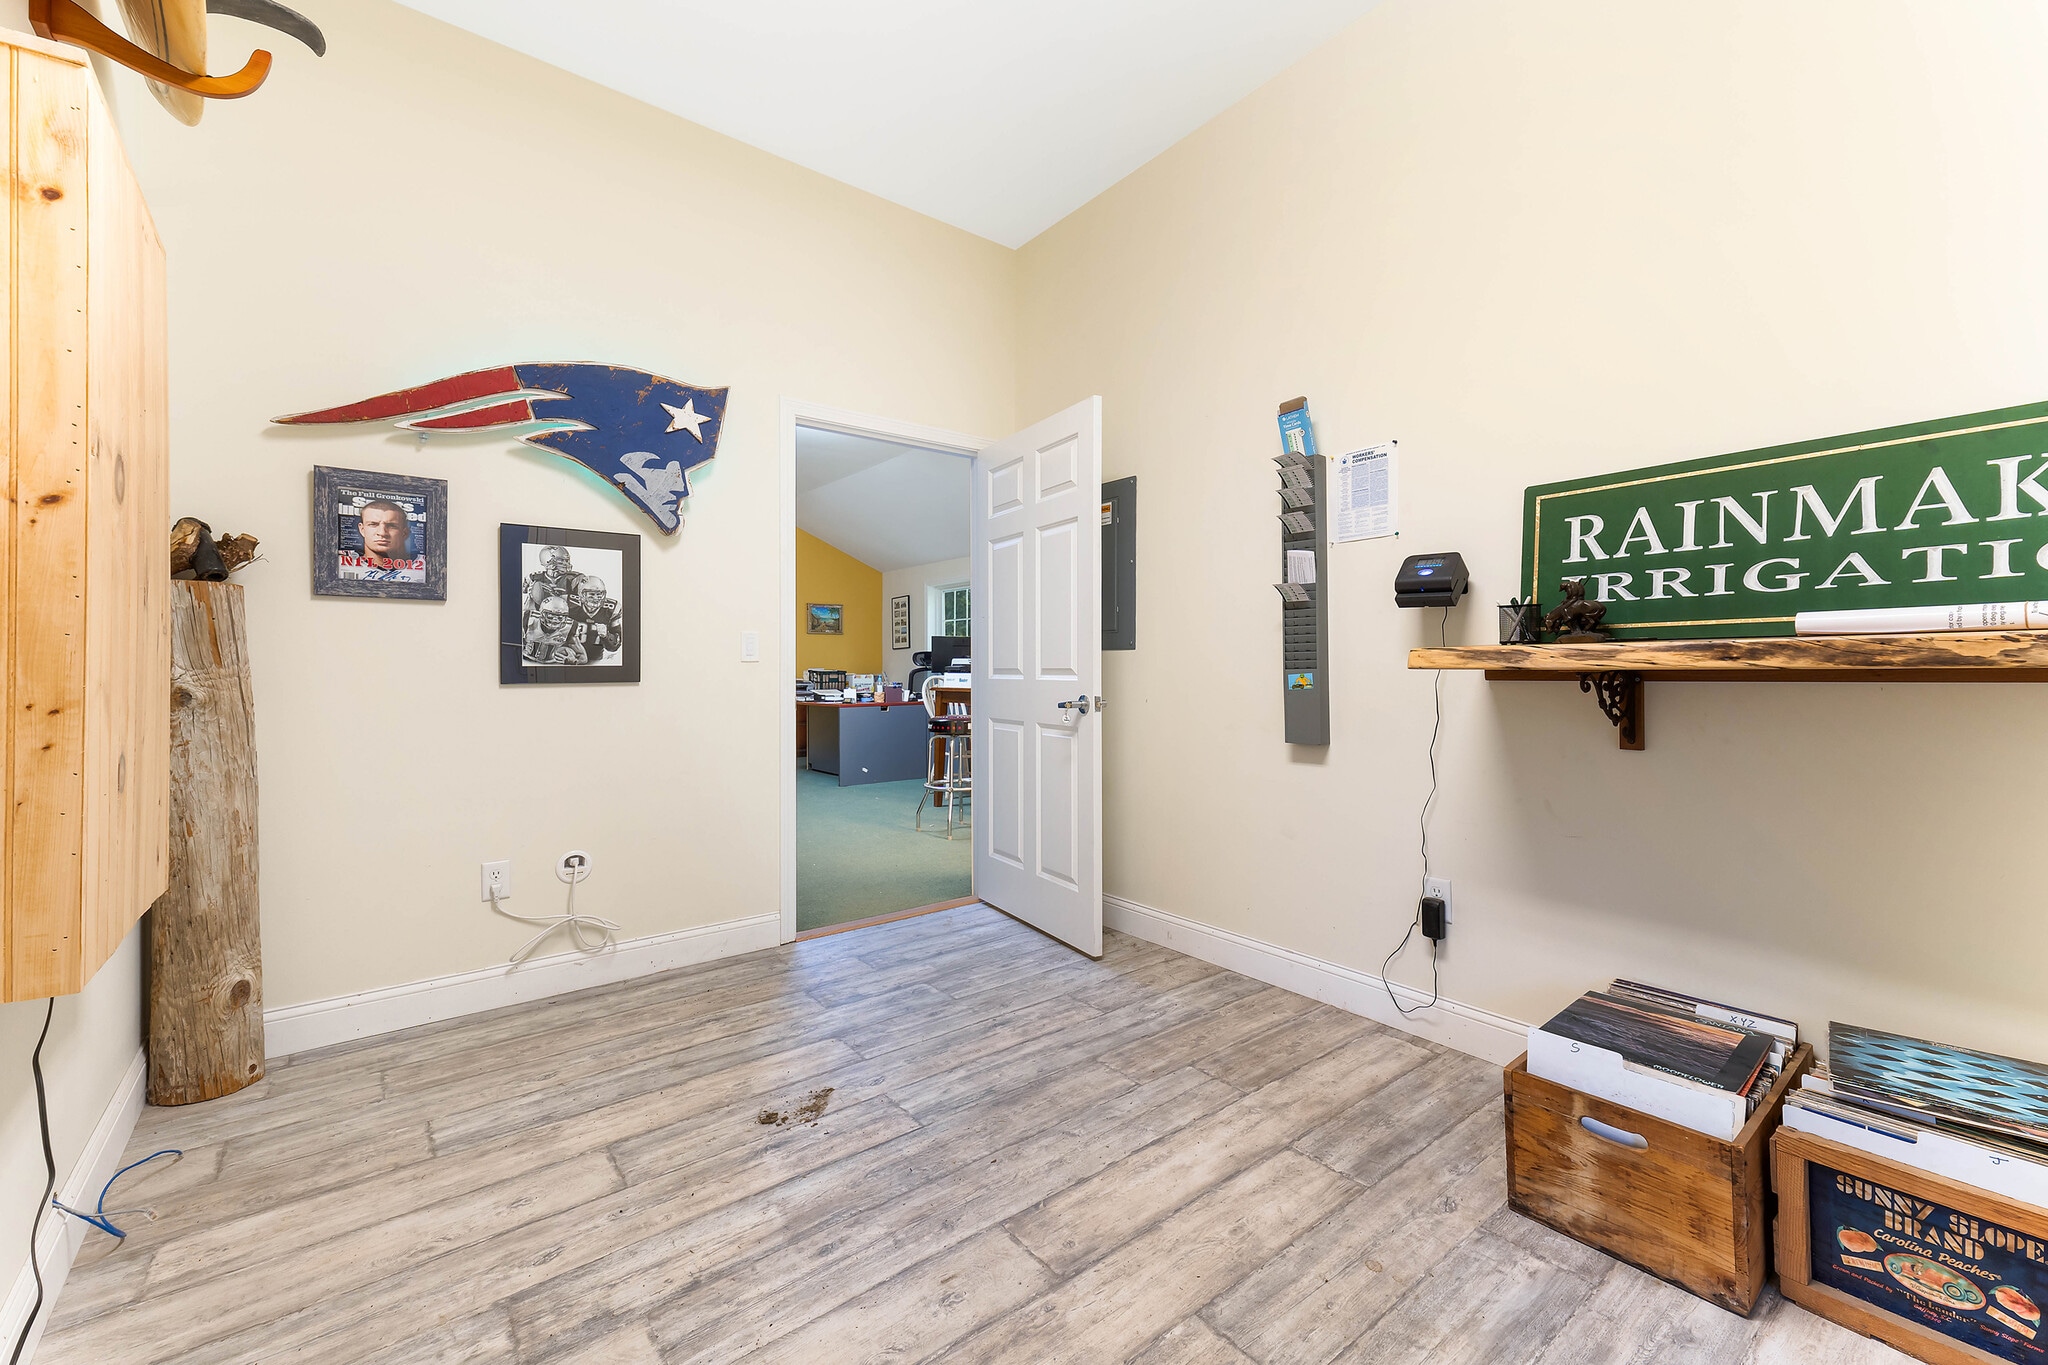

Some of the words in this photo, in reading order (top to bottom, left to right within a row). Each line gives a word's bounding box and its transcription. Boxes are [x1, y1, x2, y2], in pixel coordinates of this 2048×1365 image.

[1352, 453, 1387, 464] COMPENSATION
[376, 493, 424, 503] Gronkowski
[340, 555, 378, 568] NFL
[382, 558, 424, 571] 2012
[1561, 538, 2048, 602] RRIGATI
[1569, 1041, 1581, 1054] S
[1989, 1156, 2010, 1166] J
[1836, 1174, 1935, 1221] SUNNY
[1948, 1213, 2046, 1264] SLOPE
[1873, 1228, 1933, 1258] Carolina
[1884, 1209, 1985, 1260] BRAND
[1850, 1272, 1863, 1280] and
[1863, 1276, 1885, 1289] Packed
[1885, 1285, 1893, 1294] by
[1979, 1323, 2000, 1337] Sunny
[2001, 1332, 2019, 1343] Slope
[2023, 1341, 2045, 1354] Farms
